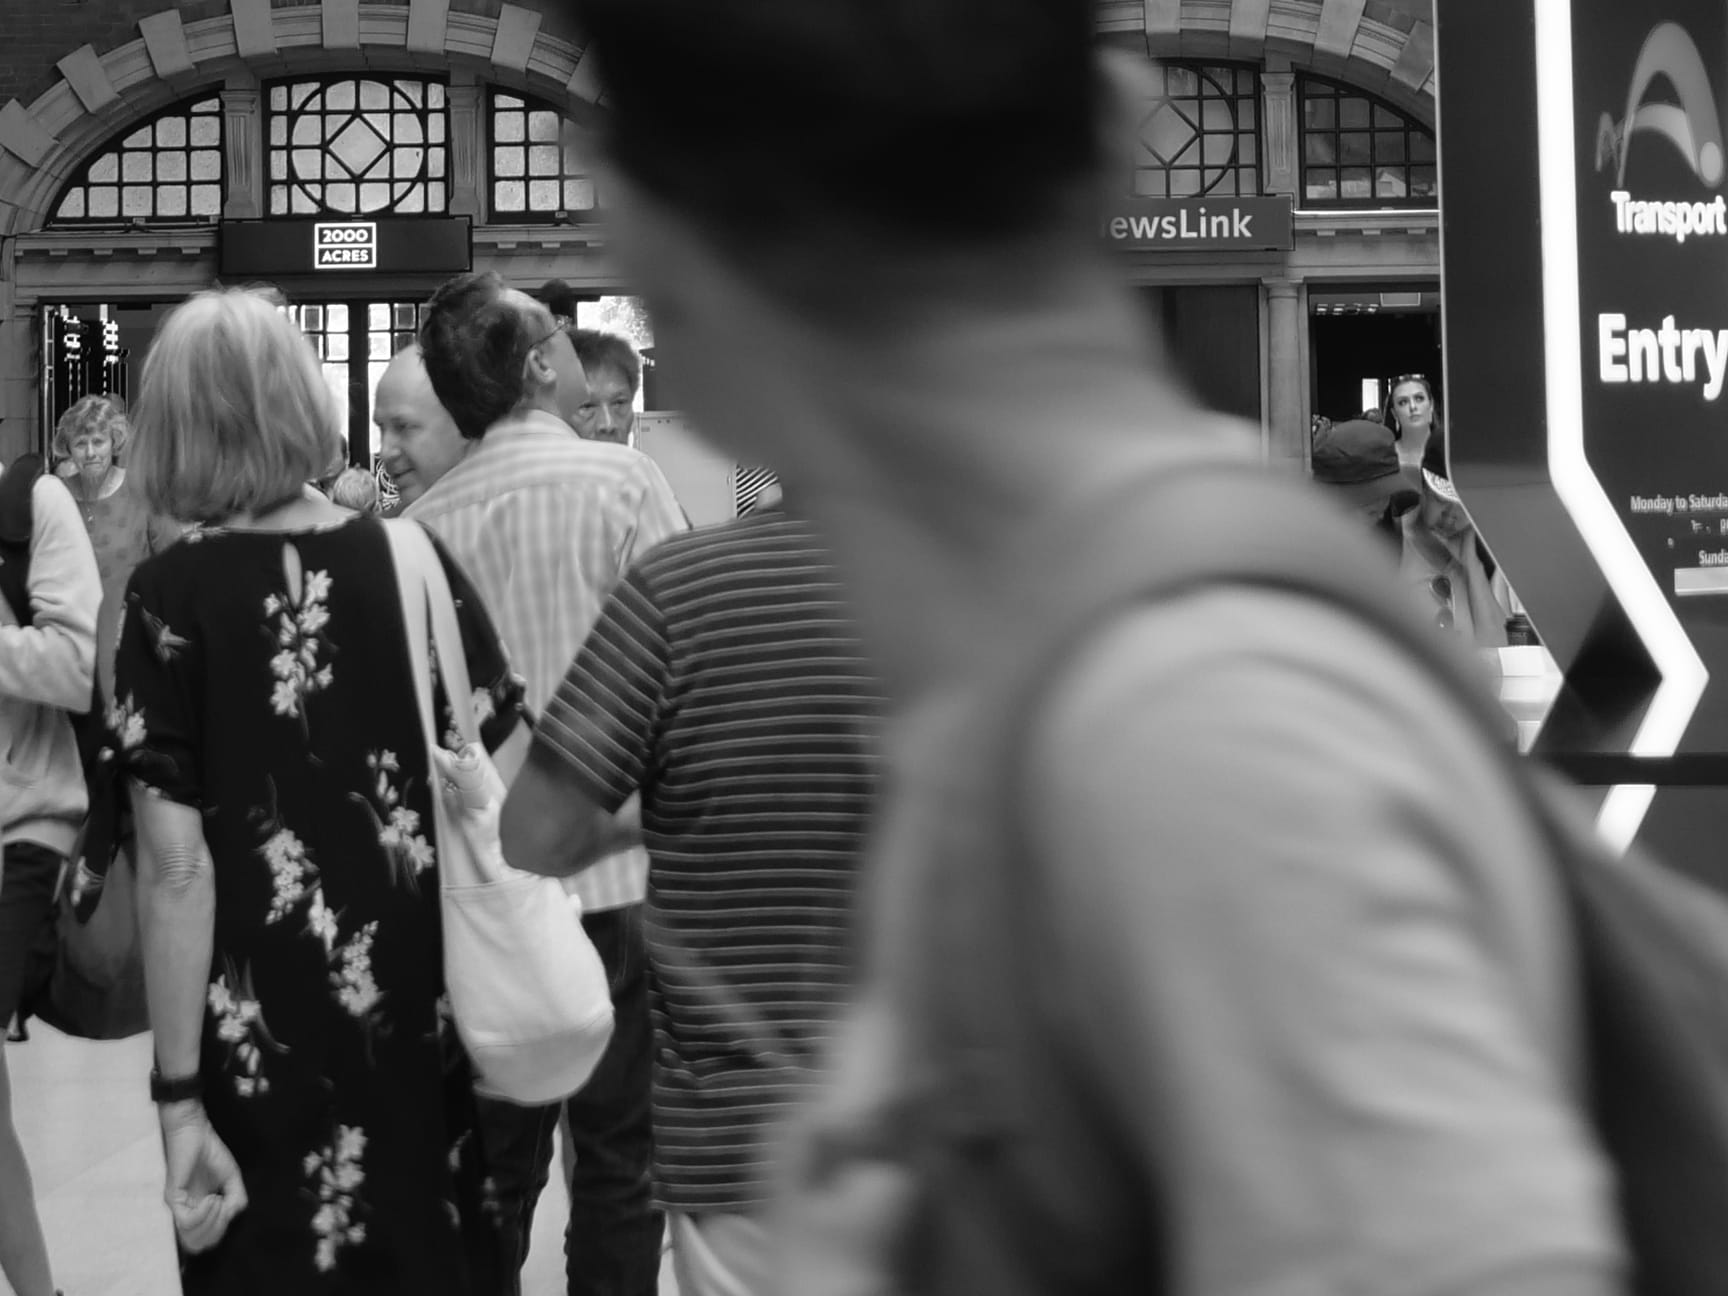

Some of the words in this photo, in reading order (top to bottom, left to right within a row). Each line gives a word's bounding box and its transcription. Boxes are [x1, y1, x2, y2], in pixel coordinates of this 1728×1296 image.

[1102, 207, 1252, 240] ewsLink
[1611, 190, 1727, 242] Transport
[323, 228, 369, 244] 2000
[322, 248, 369, 264] ACRES
[1630, 494, 1673, 515] Monday
[1674, 495, 1687, 512] to
